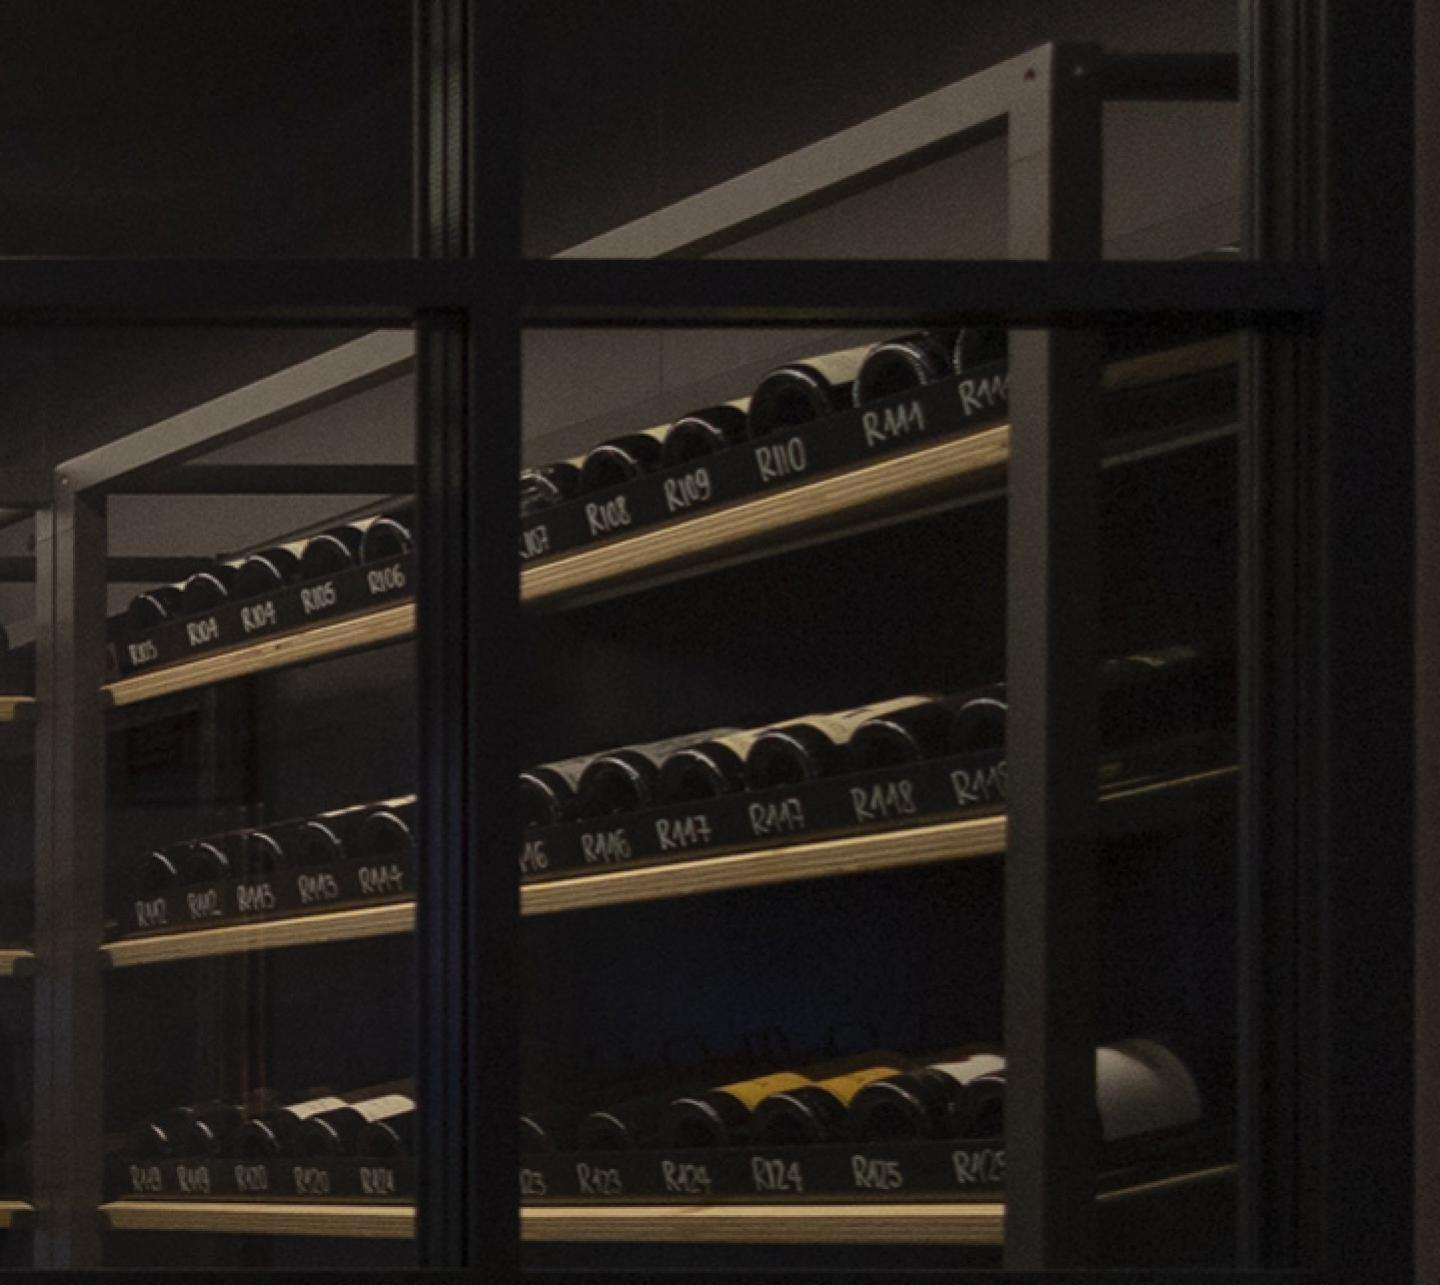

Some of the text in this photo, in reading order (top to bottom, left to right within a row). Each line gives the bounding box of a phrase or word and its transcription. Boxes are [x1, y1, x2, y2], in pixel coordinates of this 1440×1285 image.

[586, 495, 632, 536] R108
[663, 467, 711, 512] R109
[756, 438, 807, 482] R110
[862, 401, 925, 447] R111
[656, 813, 713, 852] R117
[748, 797, 805, 836] R117
